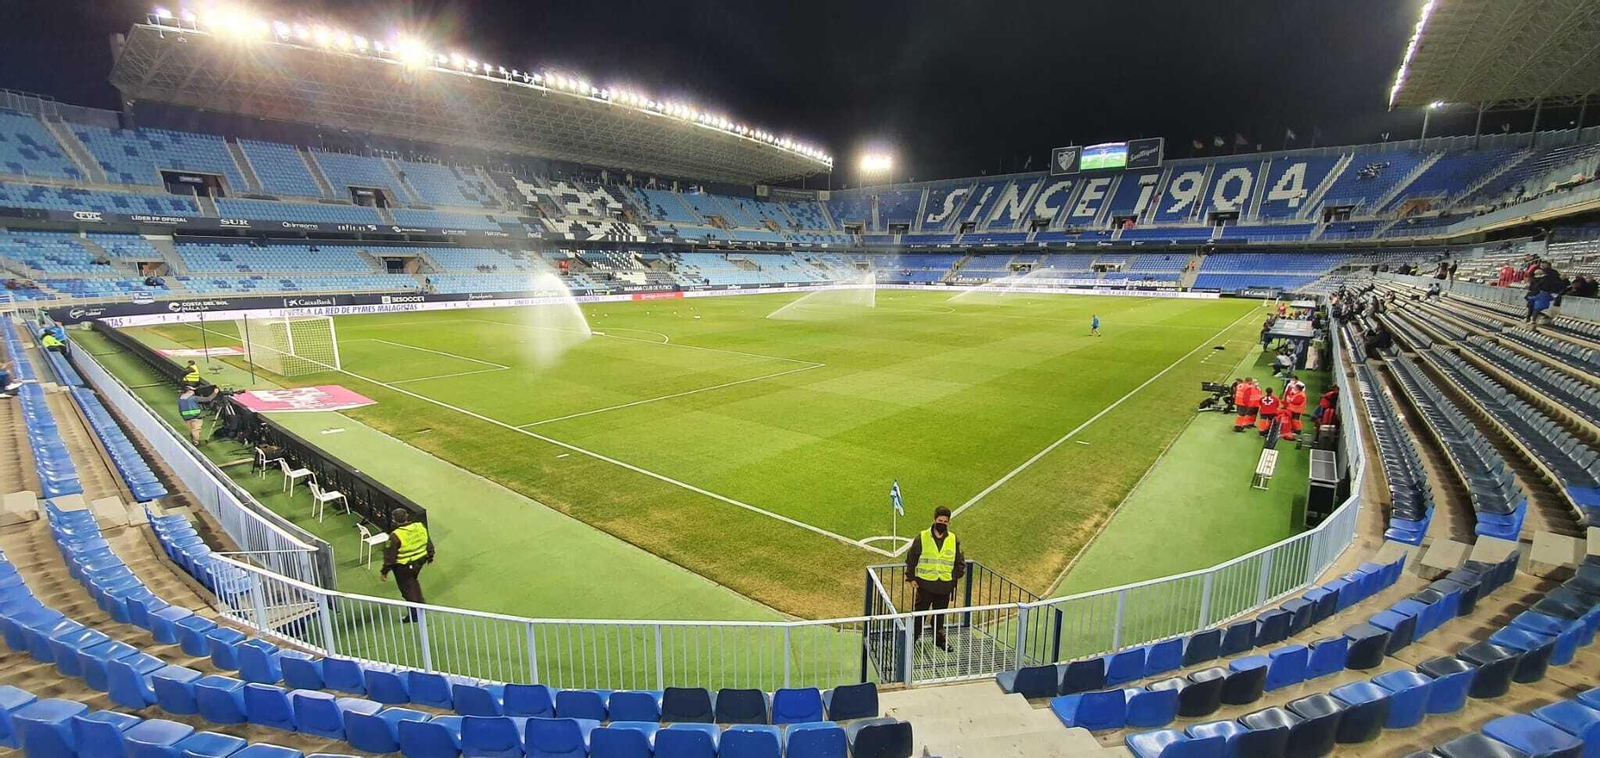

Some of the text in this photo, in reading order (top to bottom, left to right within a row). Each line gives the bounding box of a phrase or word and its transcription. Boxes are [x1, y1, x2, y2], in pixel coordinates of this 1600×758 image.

[926, 162, 1307, 223] SINCE 1904
[299, 298, 332, 307] CaixaBank
[314, 307, 323, 315] LA
[325, 307, 339, 315] RED
[341, 306, 351, 314] DE
[352, 305, 376, 313] PYMES
[377, 303, 418, 312] MALAGISTAS
